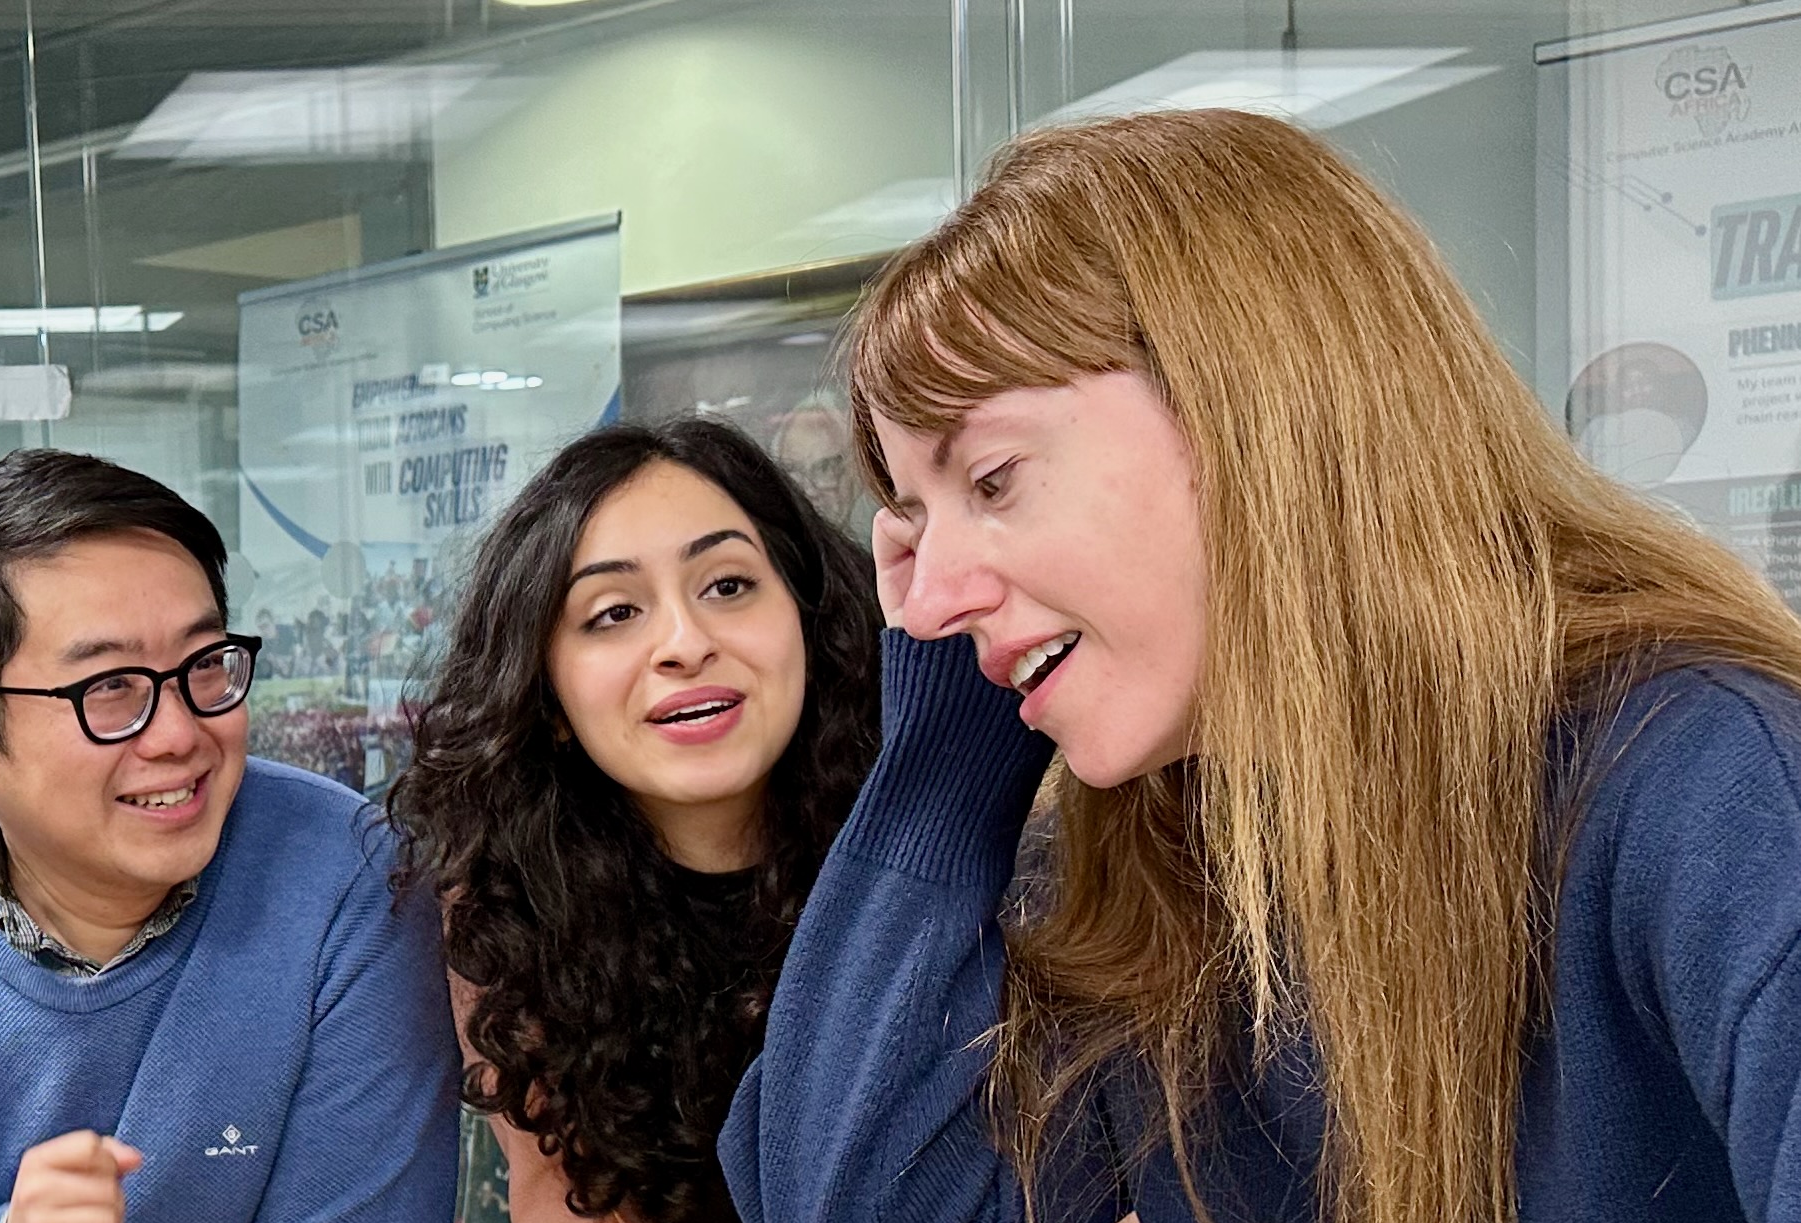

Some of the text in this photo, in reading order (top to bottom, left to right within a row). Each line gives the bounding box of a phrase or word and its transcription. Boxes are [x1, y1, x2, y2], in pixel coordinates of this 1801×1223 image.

[1664, 62, 1746, 101] CSA
[298, 310, 339, 336] CSA
[399, 443, 509, 494] COMPUTING
[423, 485, 483, 529] SKILLS
[204, 1145, 259, 1156] GANT
